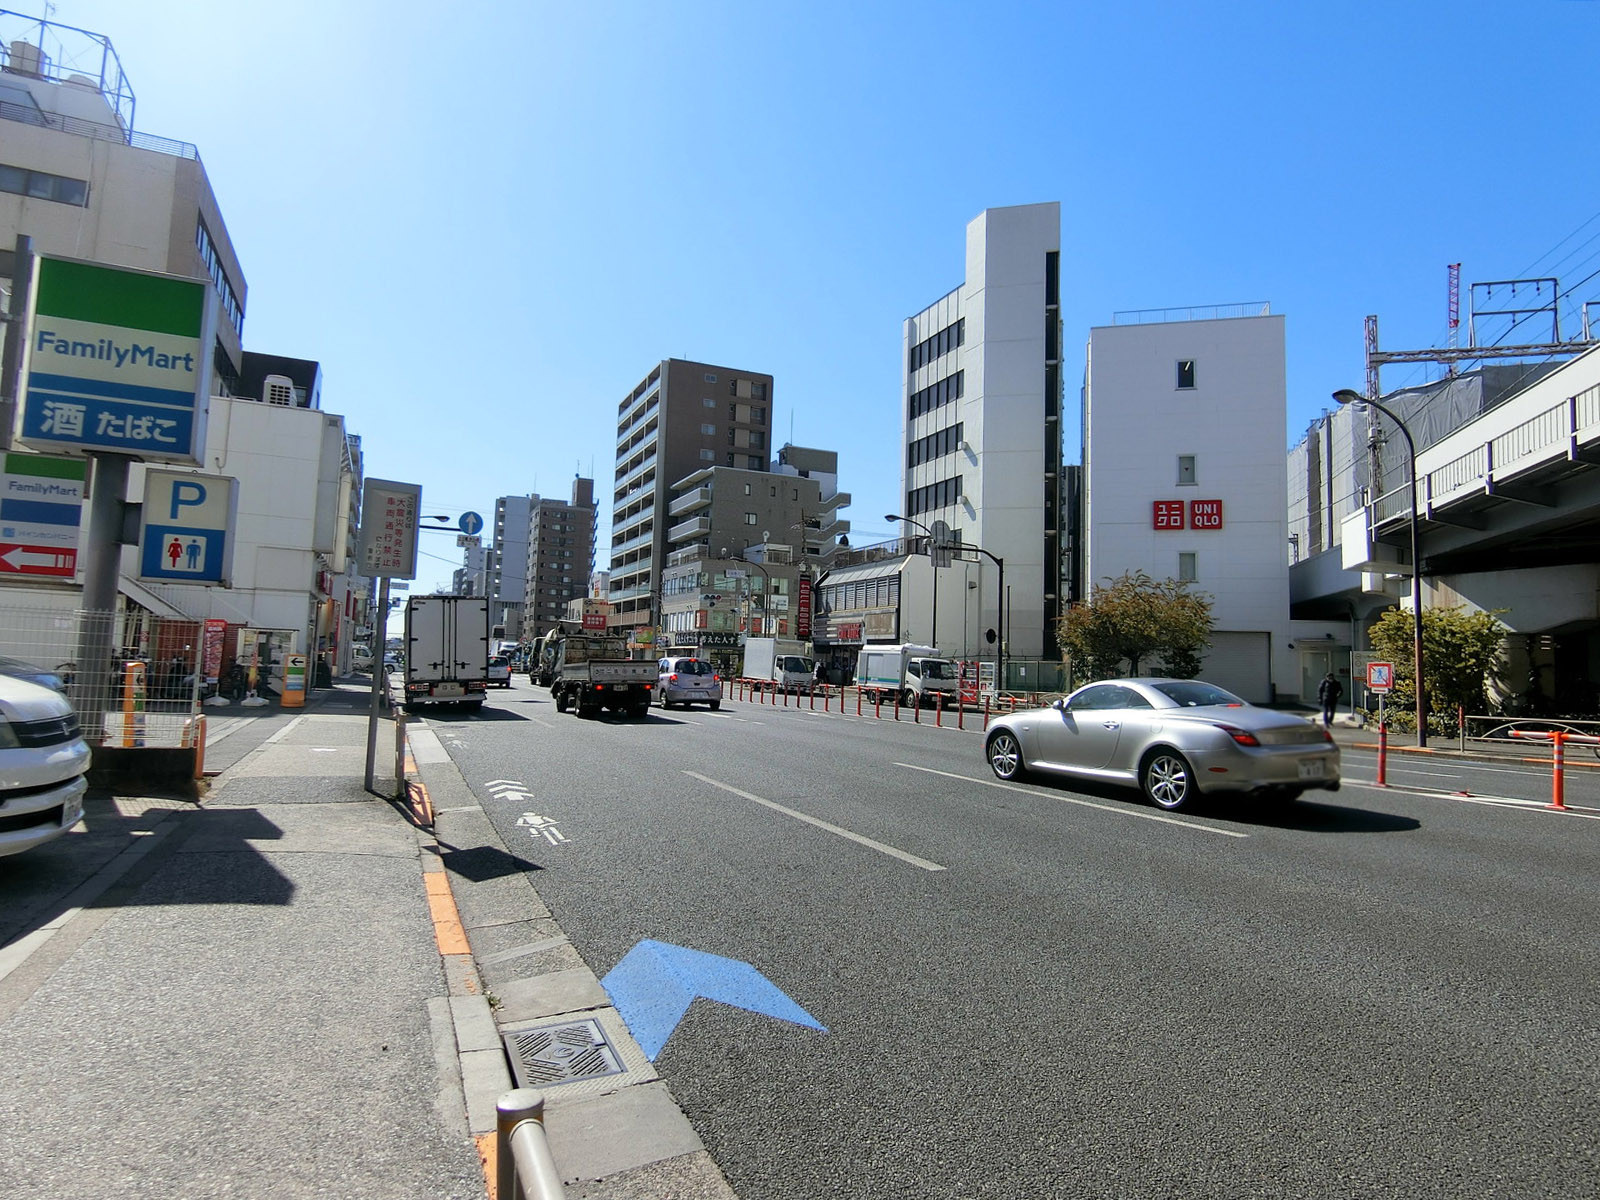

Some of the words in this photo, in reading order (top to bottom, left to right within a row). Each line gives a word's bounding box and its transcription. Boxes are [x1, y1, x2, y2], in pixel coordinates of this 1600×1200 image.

[37, 330, 194, 373] FamilyMart
[40, 401, 87, 438] 酒
[97, 411, 177, 443] たばこ
[9, 480, 78, 497] FamilyMart
[170, 480, 207, 520] P
[382, 497, 396, 567] 車両通行禁止
